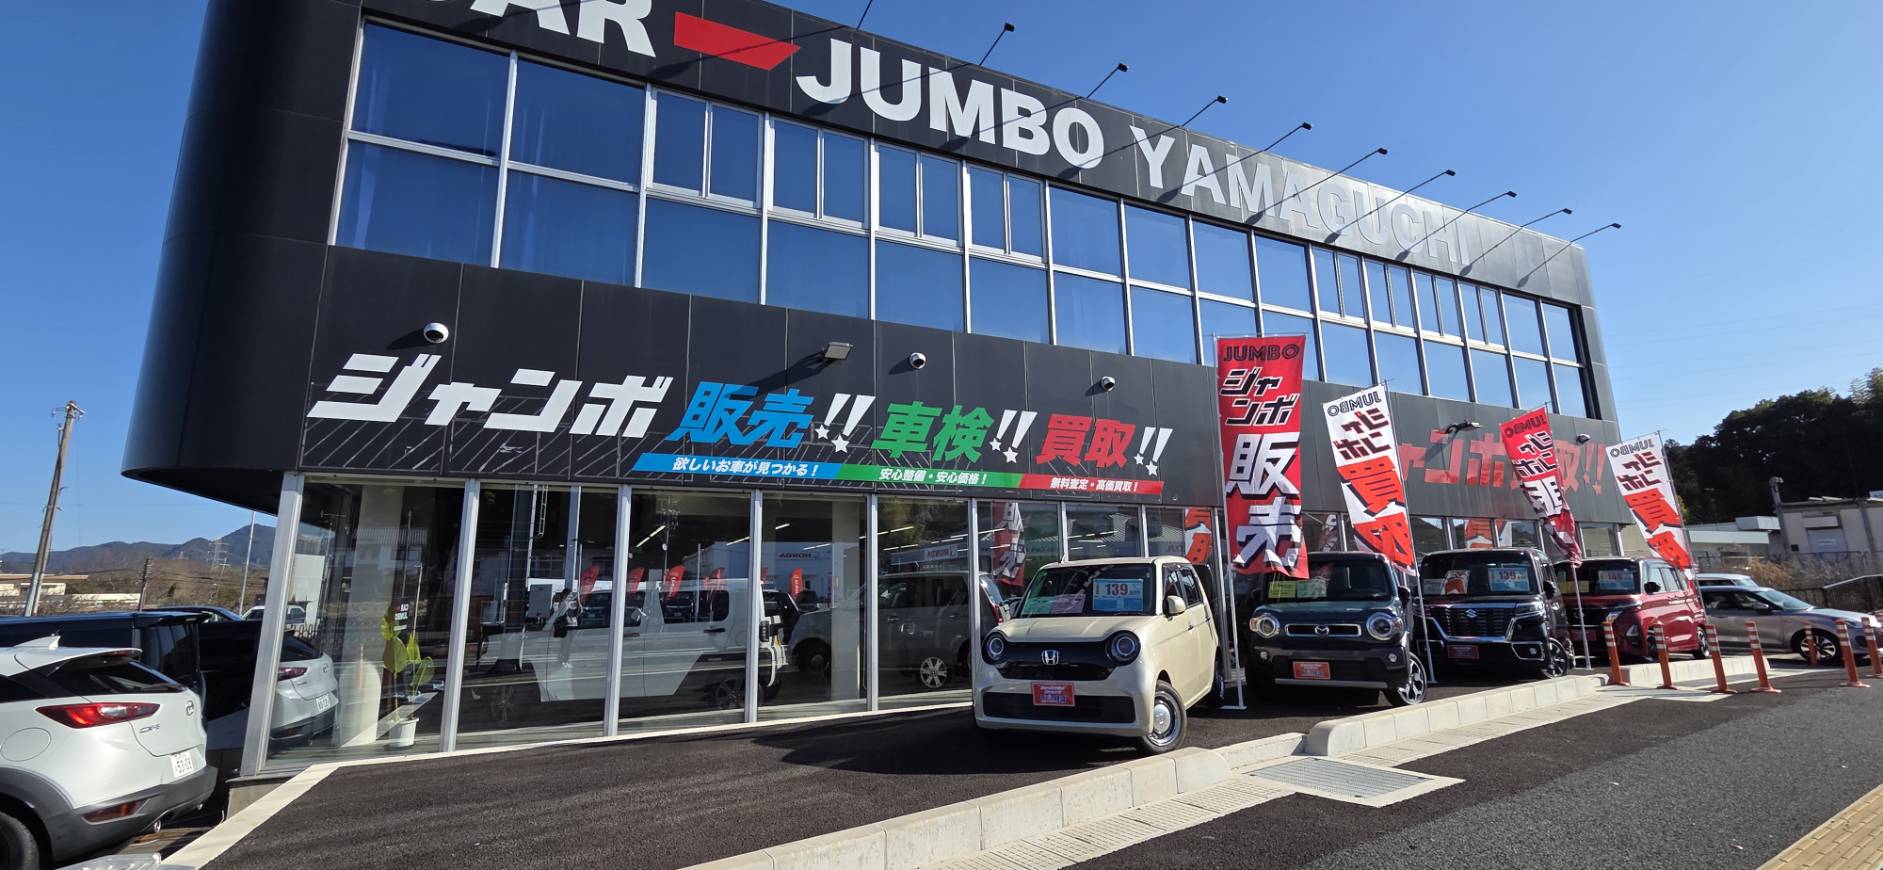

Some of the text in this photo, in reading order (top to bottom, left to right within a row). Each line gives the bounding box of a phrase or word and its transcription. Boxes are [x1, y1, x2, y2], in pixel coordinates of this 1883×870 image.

[795, 38, 1472, 266] JUMBO YAMAGUCHI
[1224, 343, 1299, 362] JUMBO
[306, 352, 674, 439] ジャンボ
[672, 456, 819, 477] 欲しいお車が見つかる！
[879, 467, 988, 486] 安心整備・安心価格！
[1050, 476, 1138, 492] 無料査定・高価買取！
[1226, 431, 1302, 569] 販売
[1105, 583, 1129, 596] 139
